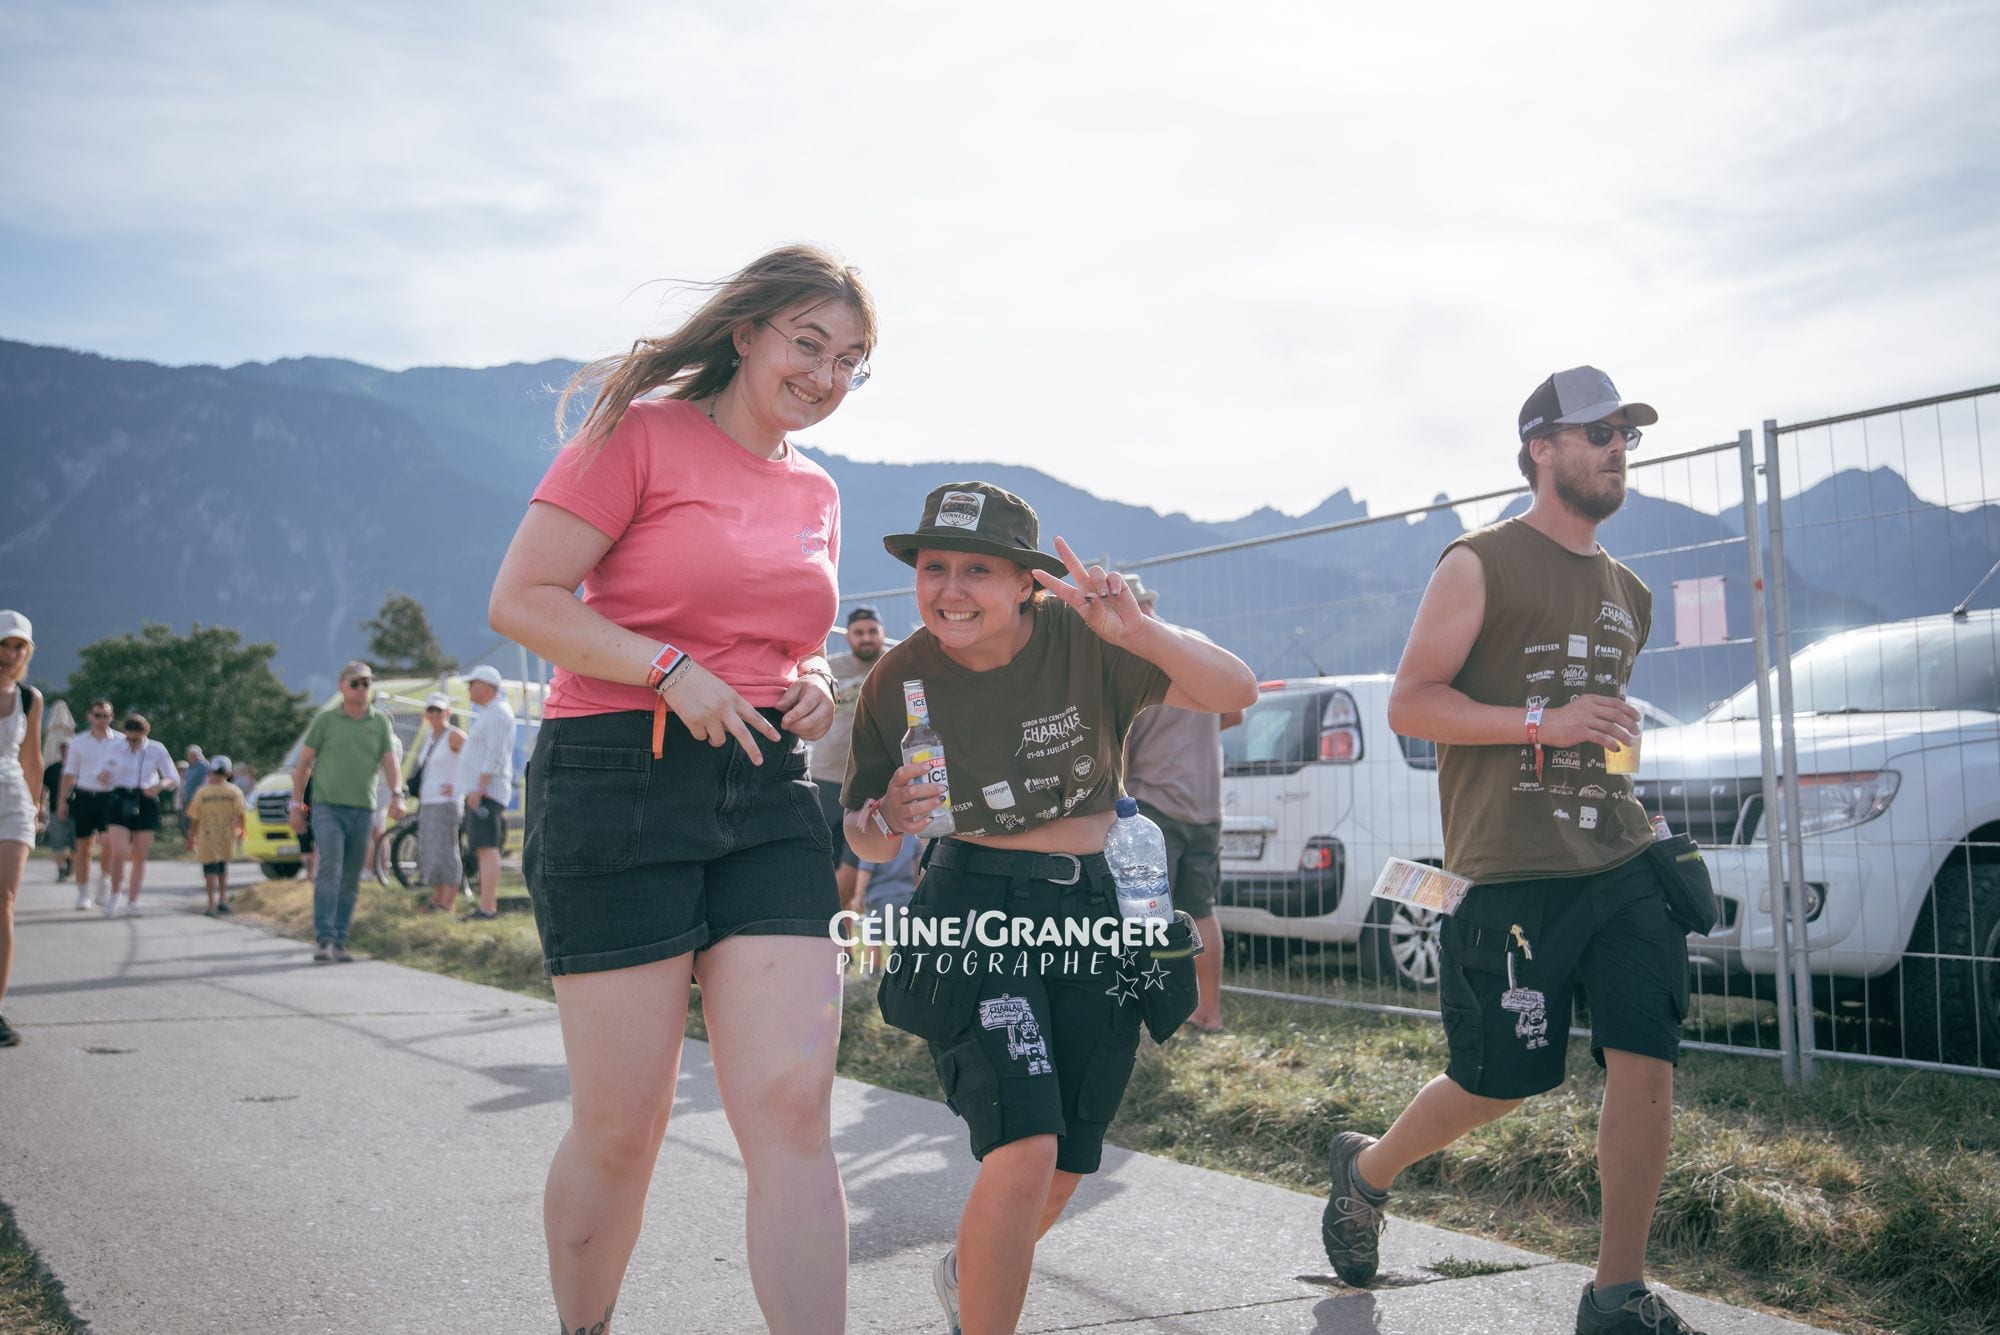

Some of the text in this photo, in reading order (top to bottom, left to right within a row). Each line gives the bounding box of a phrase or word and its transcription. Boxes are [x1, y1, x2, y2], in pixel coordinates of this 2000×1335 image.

[1524, 643, 1560, 654] RAIFFEISEN
[912, 698, 926, 707] ICE
[1026, 735, 1084, 759] 01-05 JUILLET 2026
[928, 769, 946, 784] ICE
[1632, 785, 1727, 797] GER
